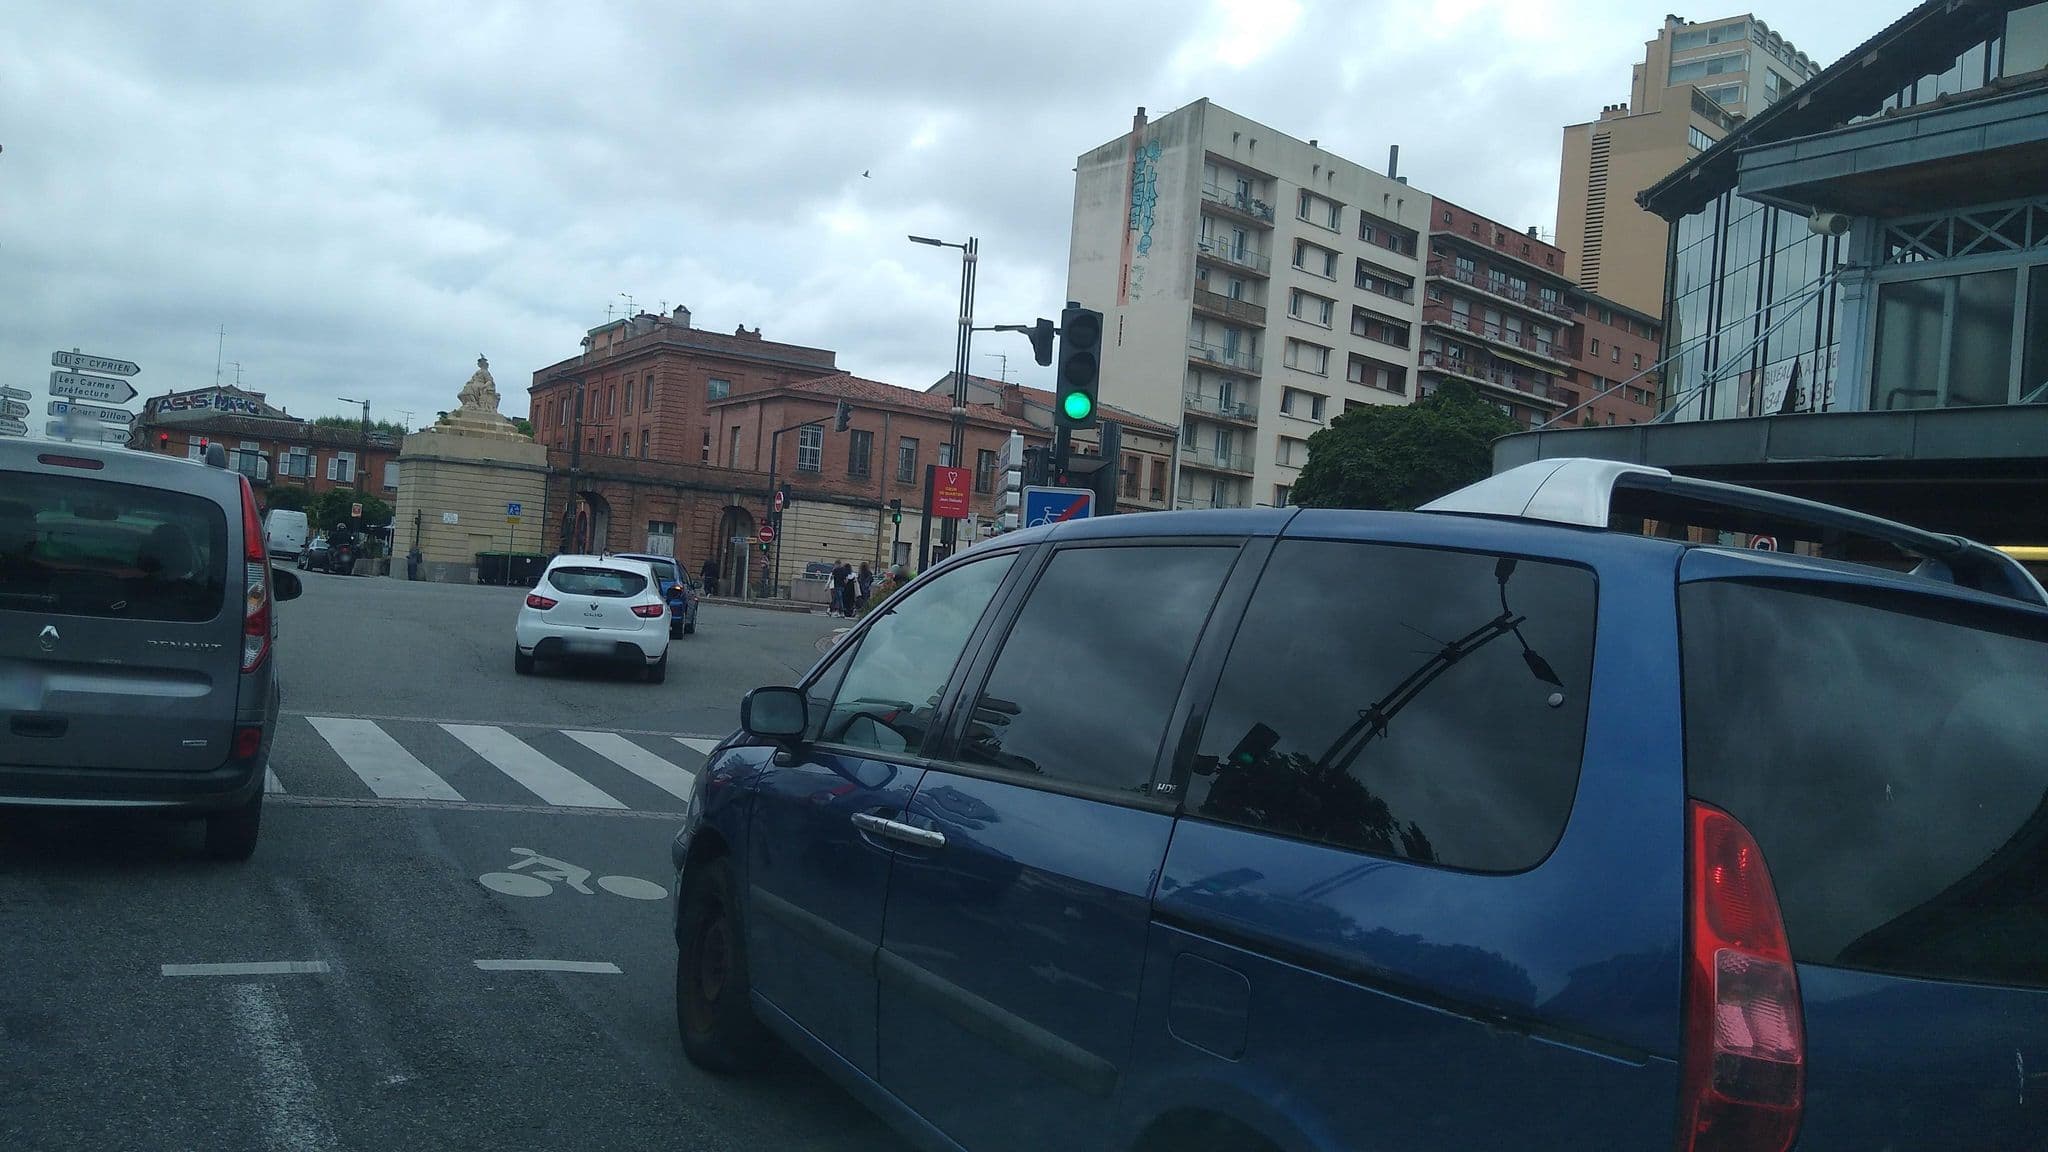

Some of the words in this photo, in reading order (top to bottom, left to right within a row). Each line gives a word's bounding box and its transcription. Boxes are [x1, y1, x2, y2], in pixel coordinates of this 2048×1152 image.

[89, 360, 131, 374] CYPRIEN
[59, 375, 75, 386] Les
[80, 377, 116, 390] Carmes
[57, 385, 110, 399] préfecture
[100, 411, 127, 421] Dillon
